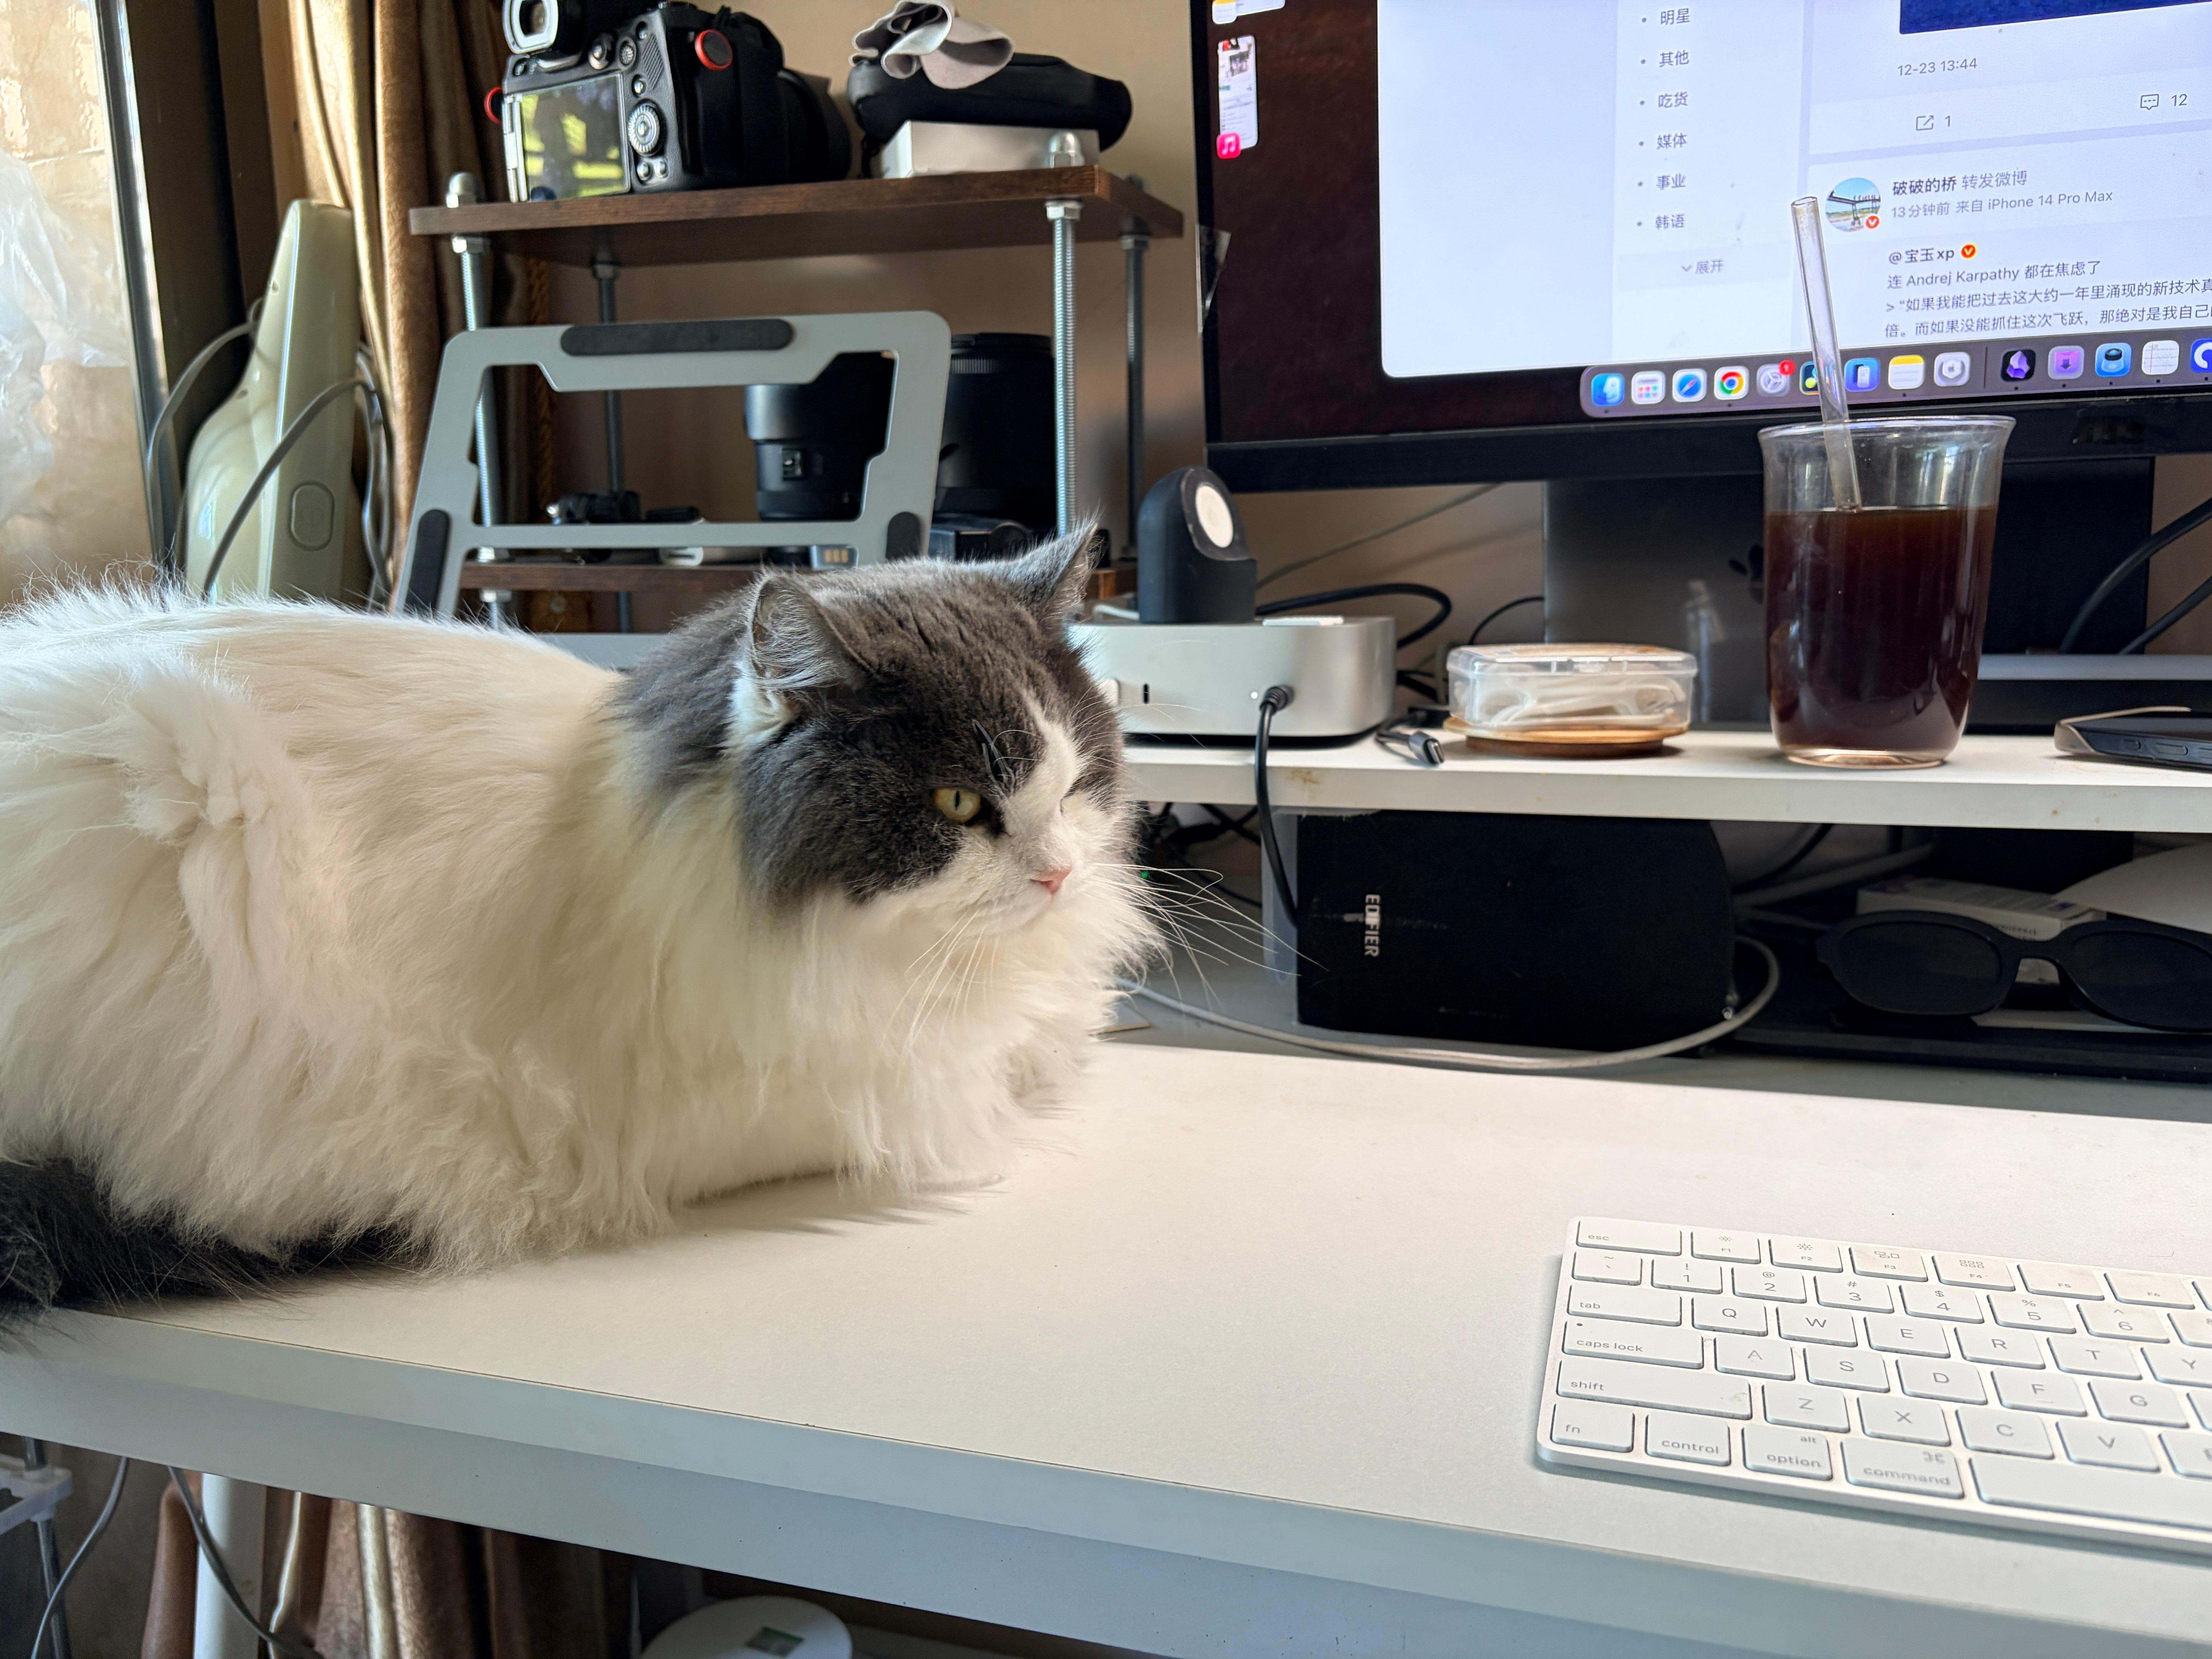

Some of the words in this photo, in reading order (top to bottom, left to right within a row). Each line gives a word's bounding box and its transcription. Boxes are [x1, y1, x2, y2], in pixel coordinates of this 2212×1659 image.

[1660, 8, 1690, 25] 明星
[1659, 50, 1690, 68] 其他
[1898, 62, 1936, 76] 12-23
[1940, 58, 1977, 72] 13:44
[1658, 91, 1688, 108] 吃货
[2171, 93, 2187, 106] 12
[1657, 132, 1687, 149] 媒体
[1656, 173, 1686, 190] 事业
[1893, 176, 1957, 196] 破破的桥
[1961, 170, 2027, 190] 转发微博
[1956, 199, 1983, 213] 来自
[1988, 197, 2033, 210] iPhone
[2038, 194, 2053, 206] 14
[2058, 193, 2080, 204] Pro
[2085, 191, 2113, 203] Max
[1655, 214, 1685, 230] 韩语
[1695, 259, 1724, 274] 展开
[1887, 275, 1901, 289] 连
[1906, 271, 1952, 287] Andrej
[1956, 267, 2020, 283] Karpathy
[2024, 261, 2100, 279] 都在焦虑了
[1365, 895, 1381, 957] EDIFIER
[1764, 1283, 1776, 1292] 2
[1849, 1292, 1862, 1301] 3
[1937, 1302, 1950, 1311] 4
[1722, 1308, 1737, 1319] Q
[2027, 1311, 2042, 1321] 5
[1805, 1317, 1827, 1328] W
[2118, 1321, 2133, 1331] 6
[1900, 1328, 1914, 1339] E
[1576, 1340, 1610, 1350] caps
[1614, 1343, 1642, 1352] lock
[1991, 1339, 2008, 1350] R
[1747, 1350, 1763, 1360] A
[2086, 1350, 2100, 1360] T
[1839, 1361, 1855, 1372] S
[2181, 1359, 2196, 1370] Y
[1933, 1372, 1950, 1383] D
[1571, 1381, 1604, 1391] shift
[2031, 1384, 2044, 1394] F
[1798, 1398, 1814, 1410] Z
[2129, 1395, 2148, 1407] G
[1895, 1411, 1913, 1424] X
[1566, 1424, 1580, 1434] fn
[1996, 1424, 2014, 1437] C
[1661, 1440, 1719, 1454] control
[2097, 1436, 2115, 1449] V
[1767, 1454, 1822, 1468] option
[1863, 1467, 1950, 1486] command
